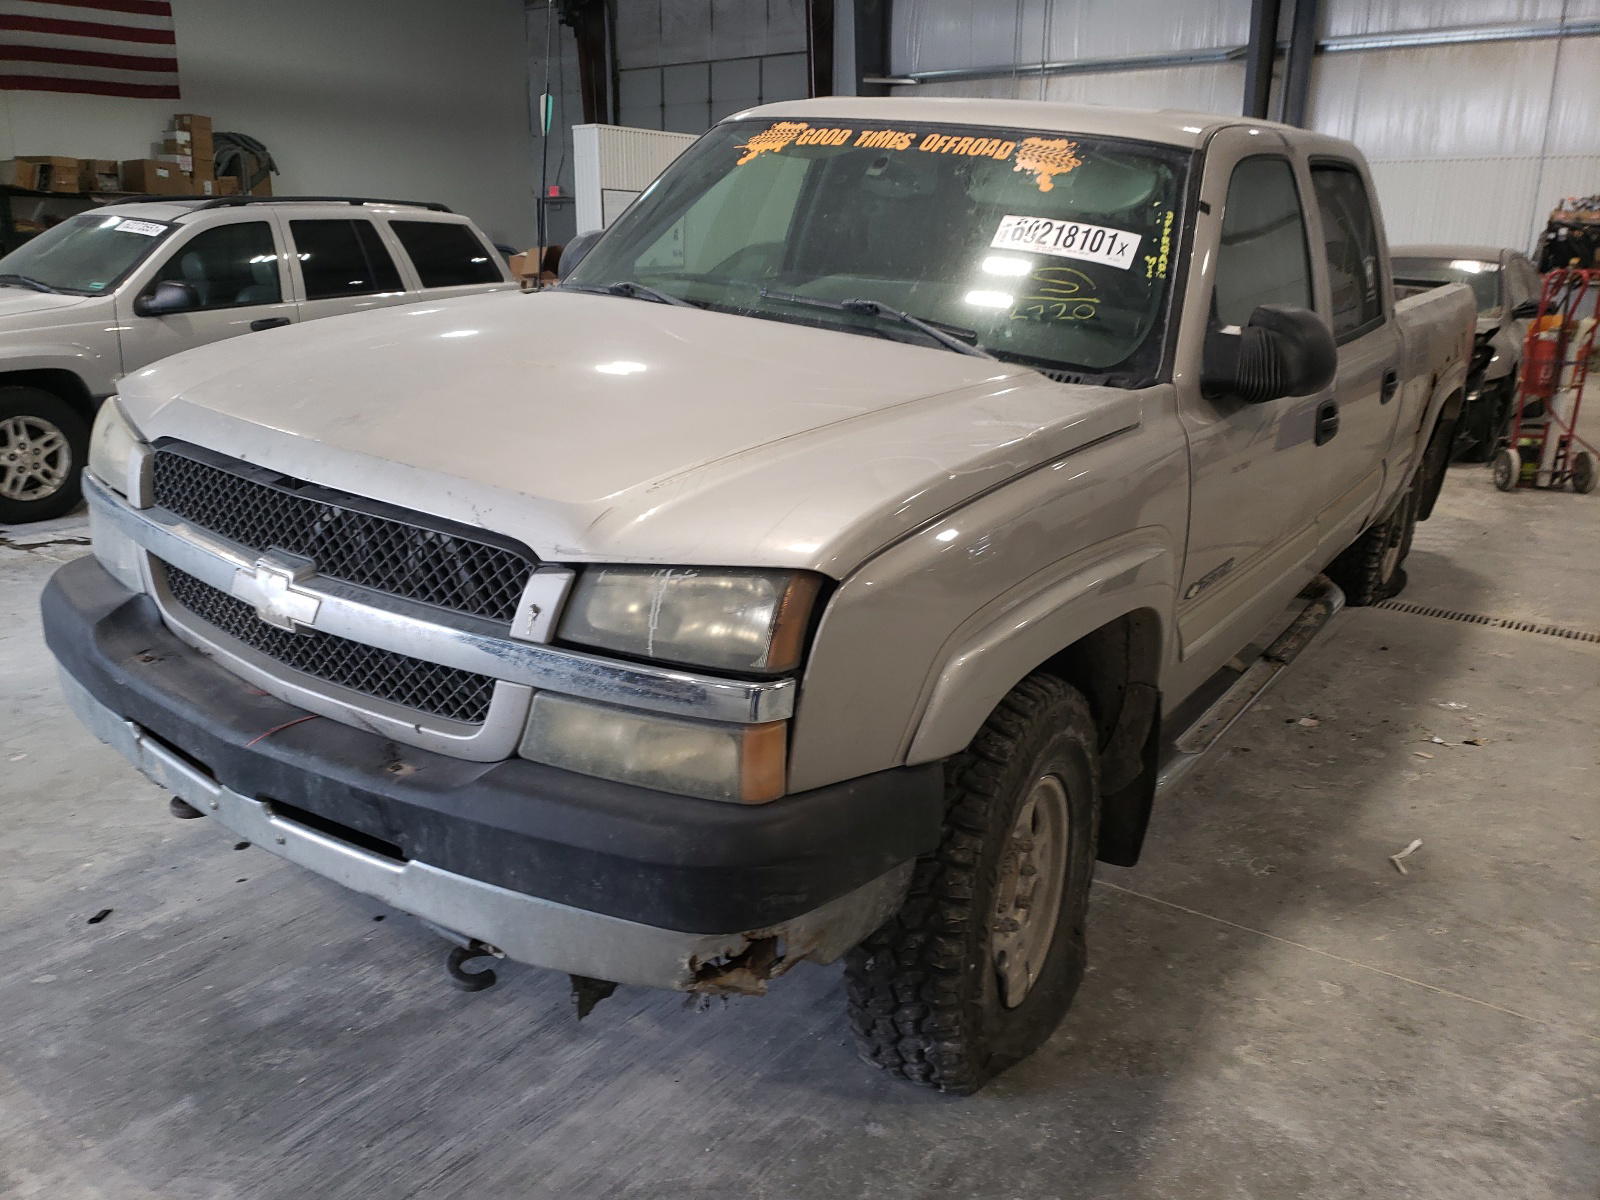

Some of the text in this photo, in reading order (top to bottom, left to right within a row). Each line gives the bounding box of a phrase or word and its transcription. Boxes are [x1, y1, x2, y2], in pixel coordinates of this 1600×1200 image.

[795, 128, 1017, 160] GOOD TIMES OFFROAD
